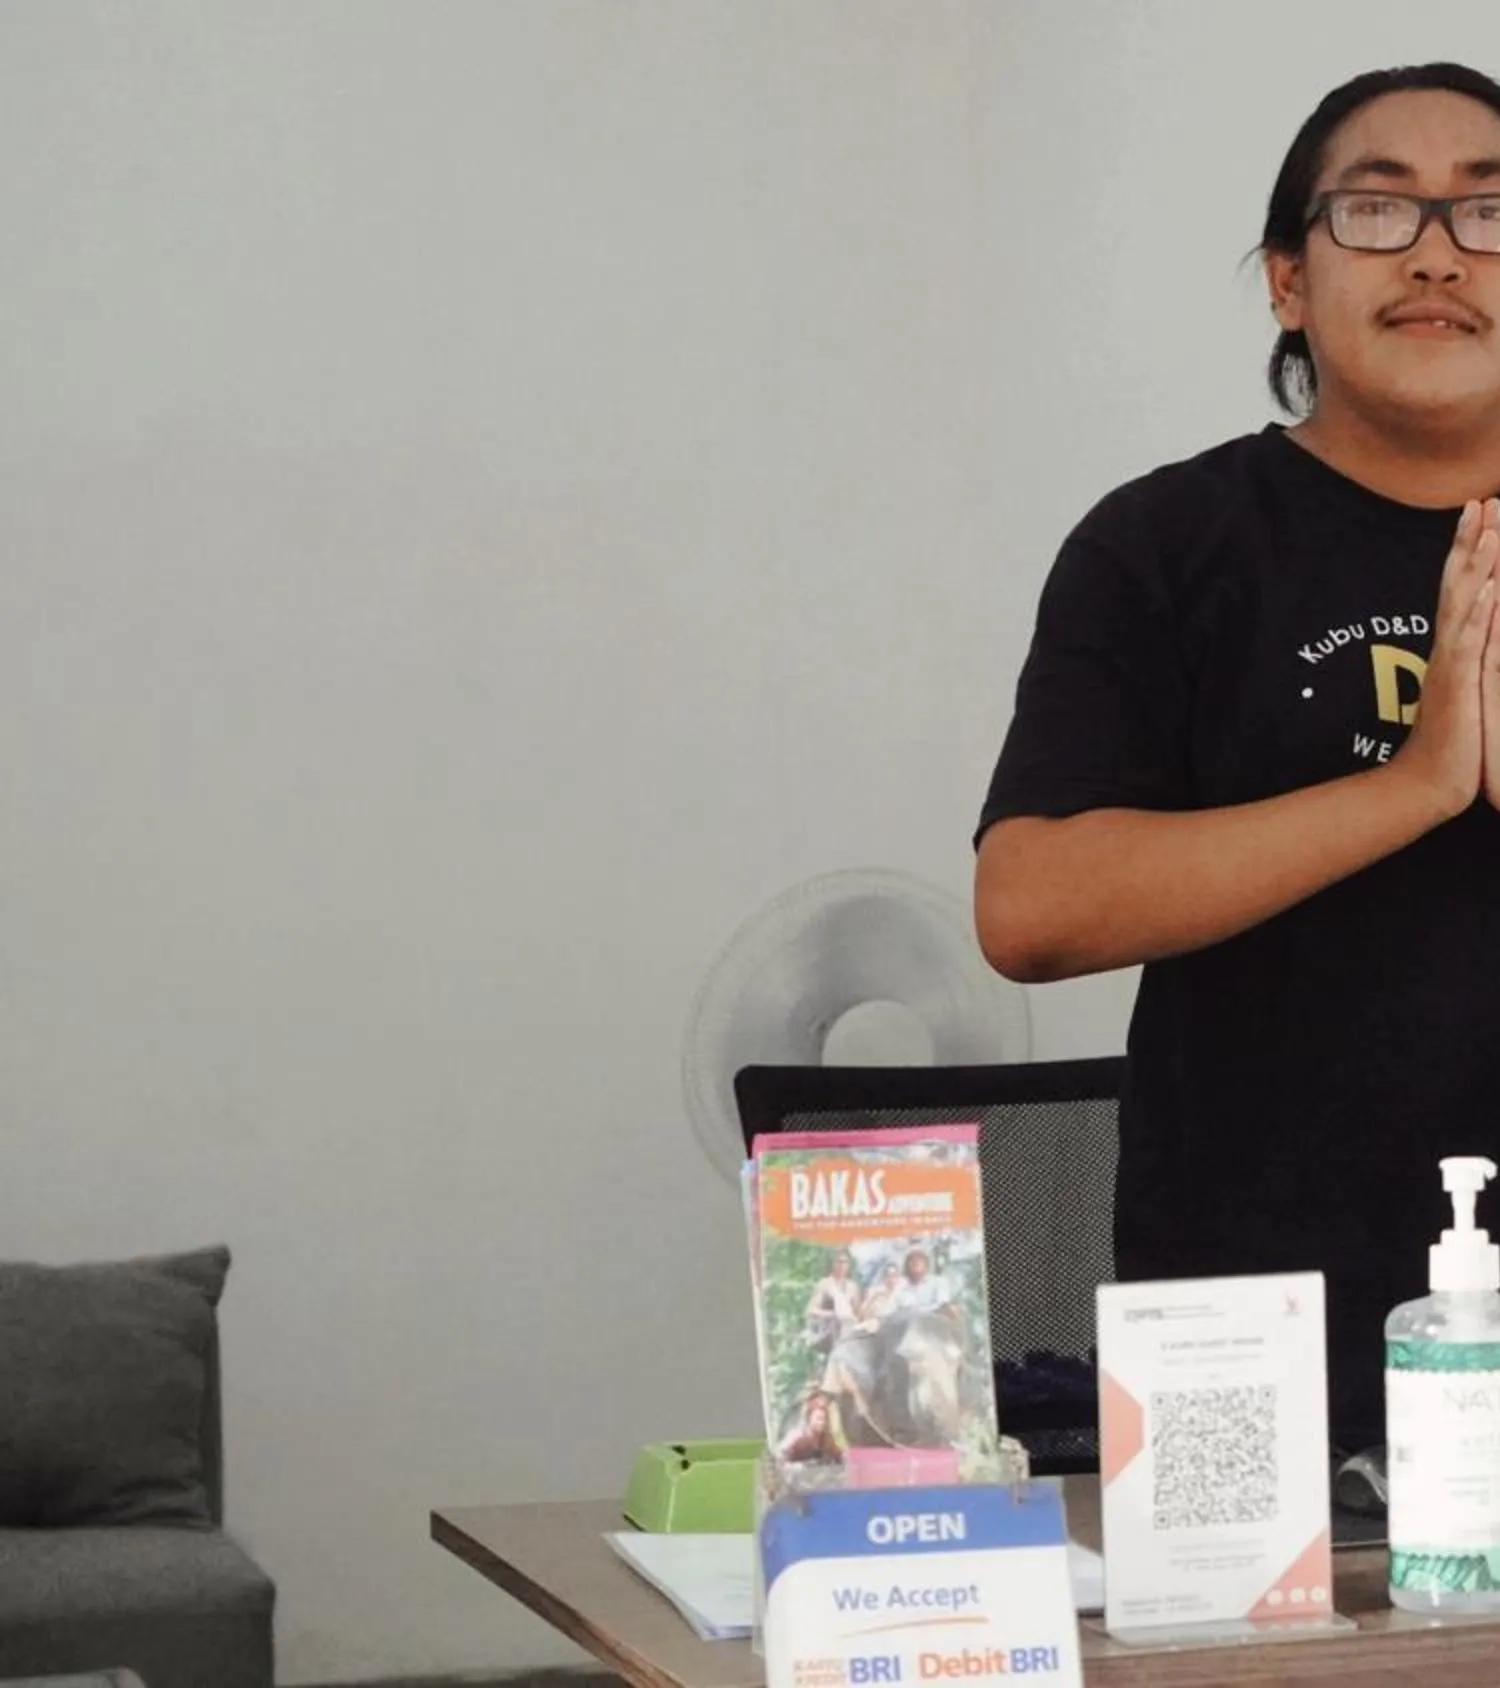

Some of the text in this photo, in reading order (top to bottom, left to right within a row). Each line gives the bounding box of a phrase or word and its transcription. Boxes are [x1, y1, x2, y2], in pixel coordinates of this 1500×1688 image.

[1298, 620, 1366, 666] Kubu
[1371, 614, 1430, 637] D&D
[790, 1168, 887, 1219] BAKAS
[866, 1512, 967, 1545] OPEN
[832, 1584, 981, 1612] We Accept
[849, 1655, 902, 1685] BRI
